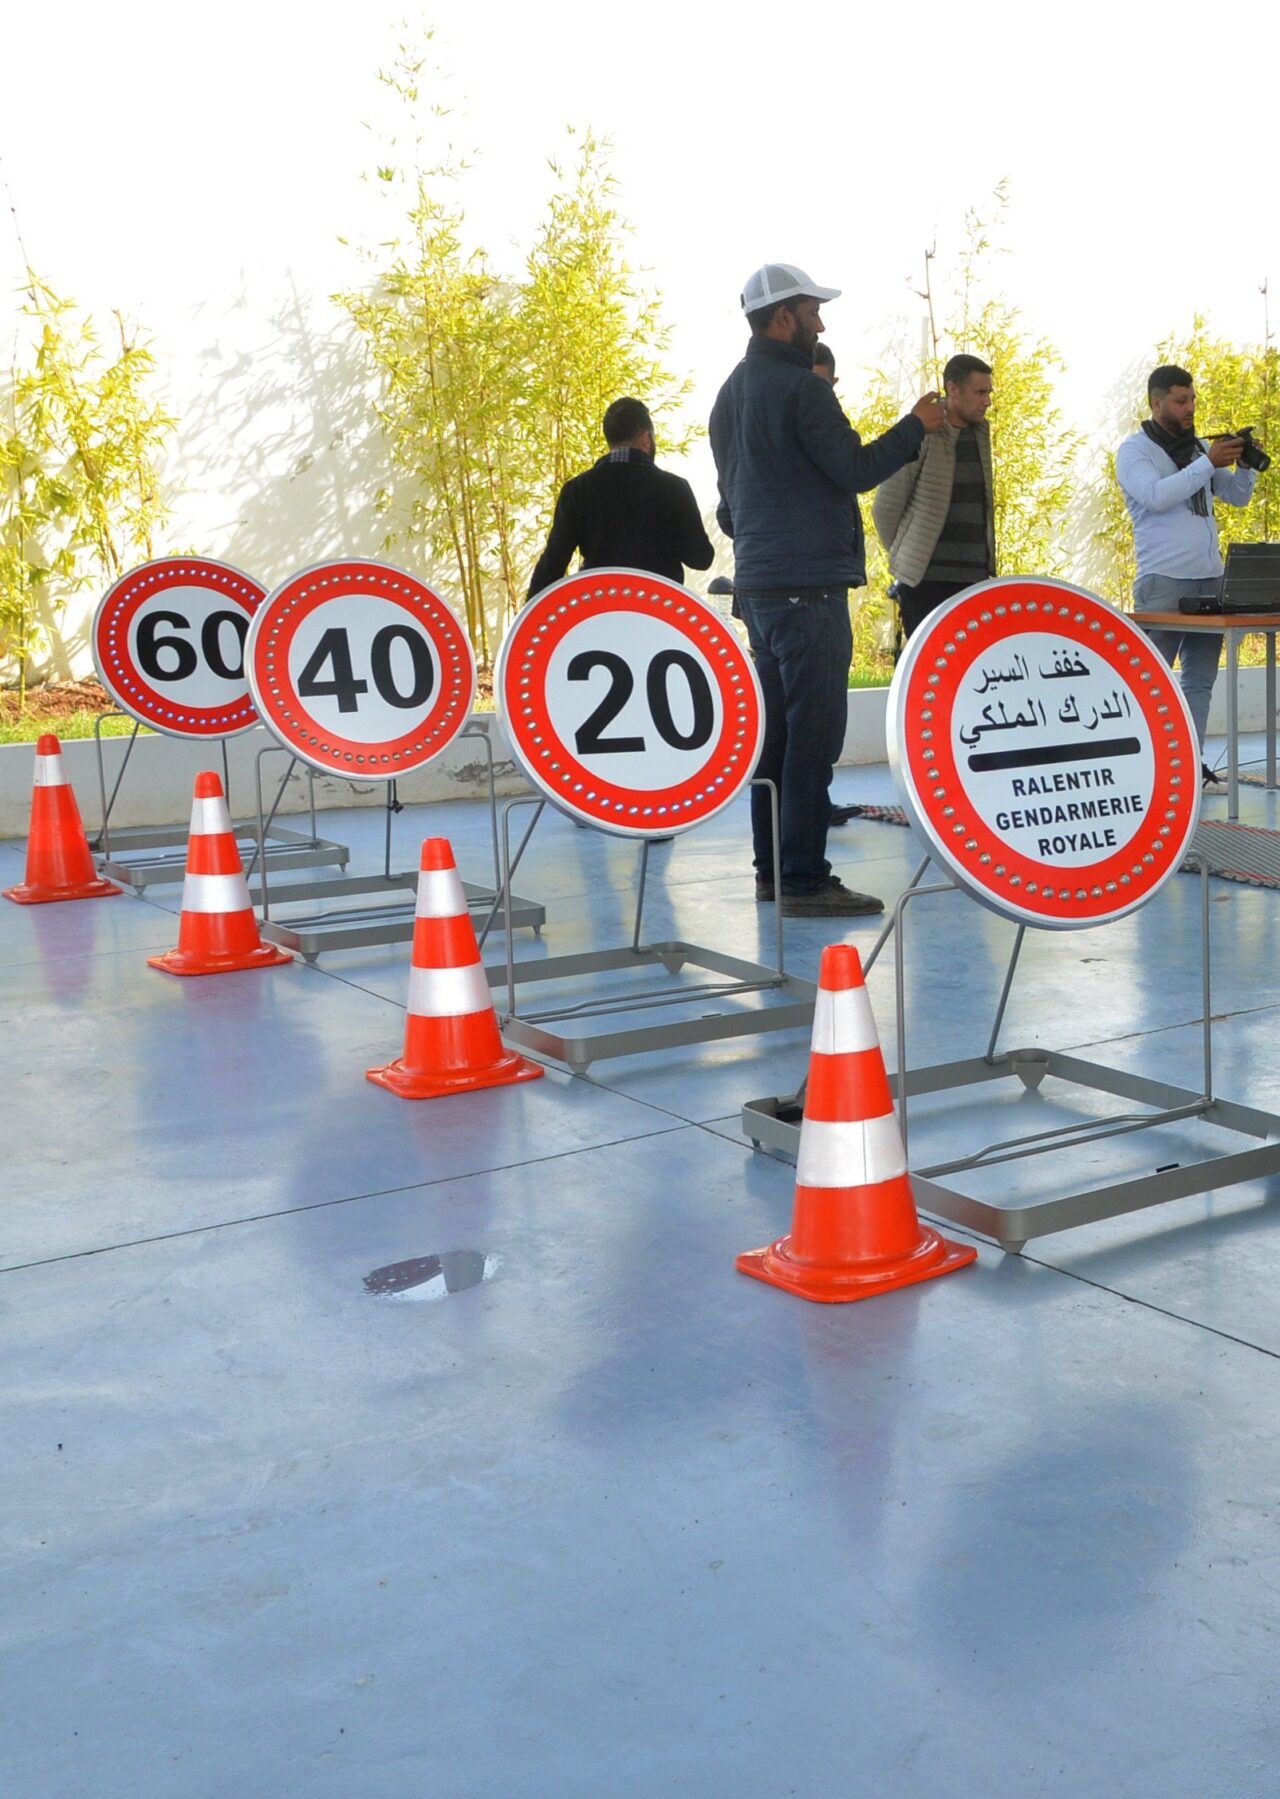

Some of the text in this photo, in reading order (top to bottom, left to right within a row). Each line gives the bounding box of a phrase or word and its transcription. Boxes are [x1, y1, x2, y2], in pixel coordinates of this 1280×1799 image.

[135, 609, 248, 682] 60
[297, 624, 434, 713] 40
[973, 650, 1090, 694] خفف السير
[566, 649, 714, 755] 20
[959, 690, 1131, 749] الدرك الملكي
[1012, 767, 1115, 797] RALENTIR
[996, 794, 1144, 831] GENDARMERIE
[1038, 829, 1117, 857] ROYALE
